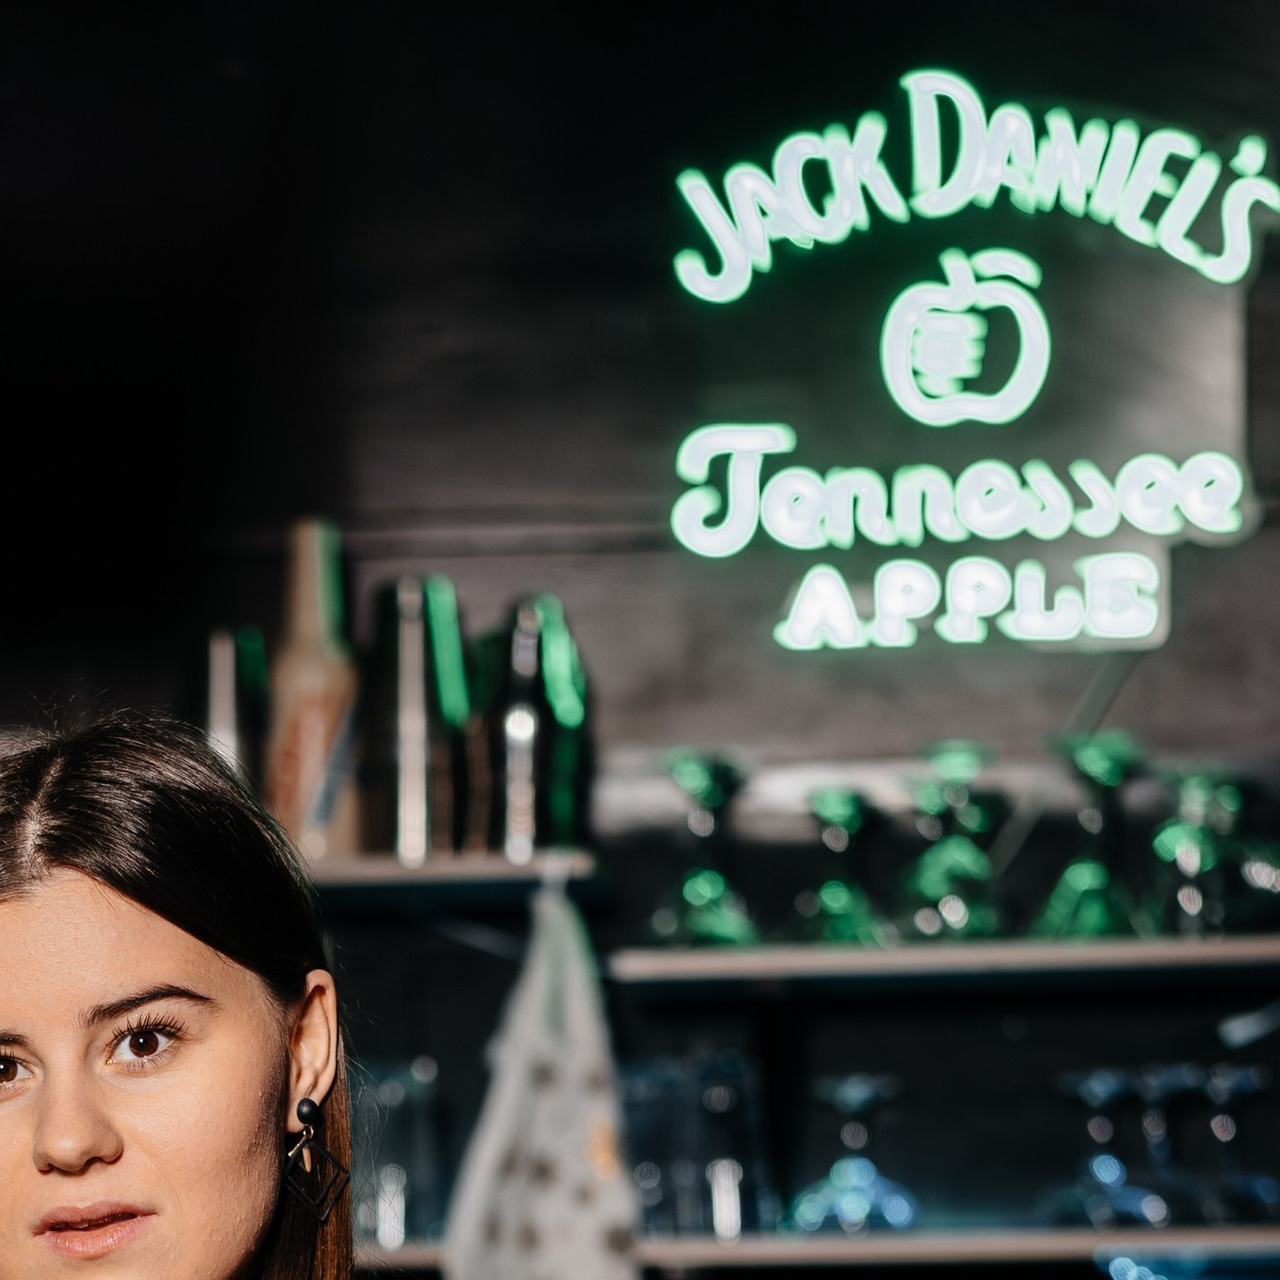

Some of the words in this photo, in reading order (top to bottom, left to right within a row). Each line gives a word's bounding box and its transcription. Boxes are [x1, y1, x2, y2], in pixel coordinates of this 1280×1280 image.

[674, 110, 912, 304] JACK
[900, 68, 1280, 285] DANIEL'S
[670, 422, 1245, 559] Tennessee
[773, 551, 1162, 651] APPLE
